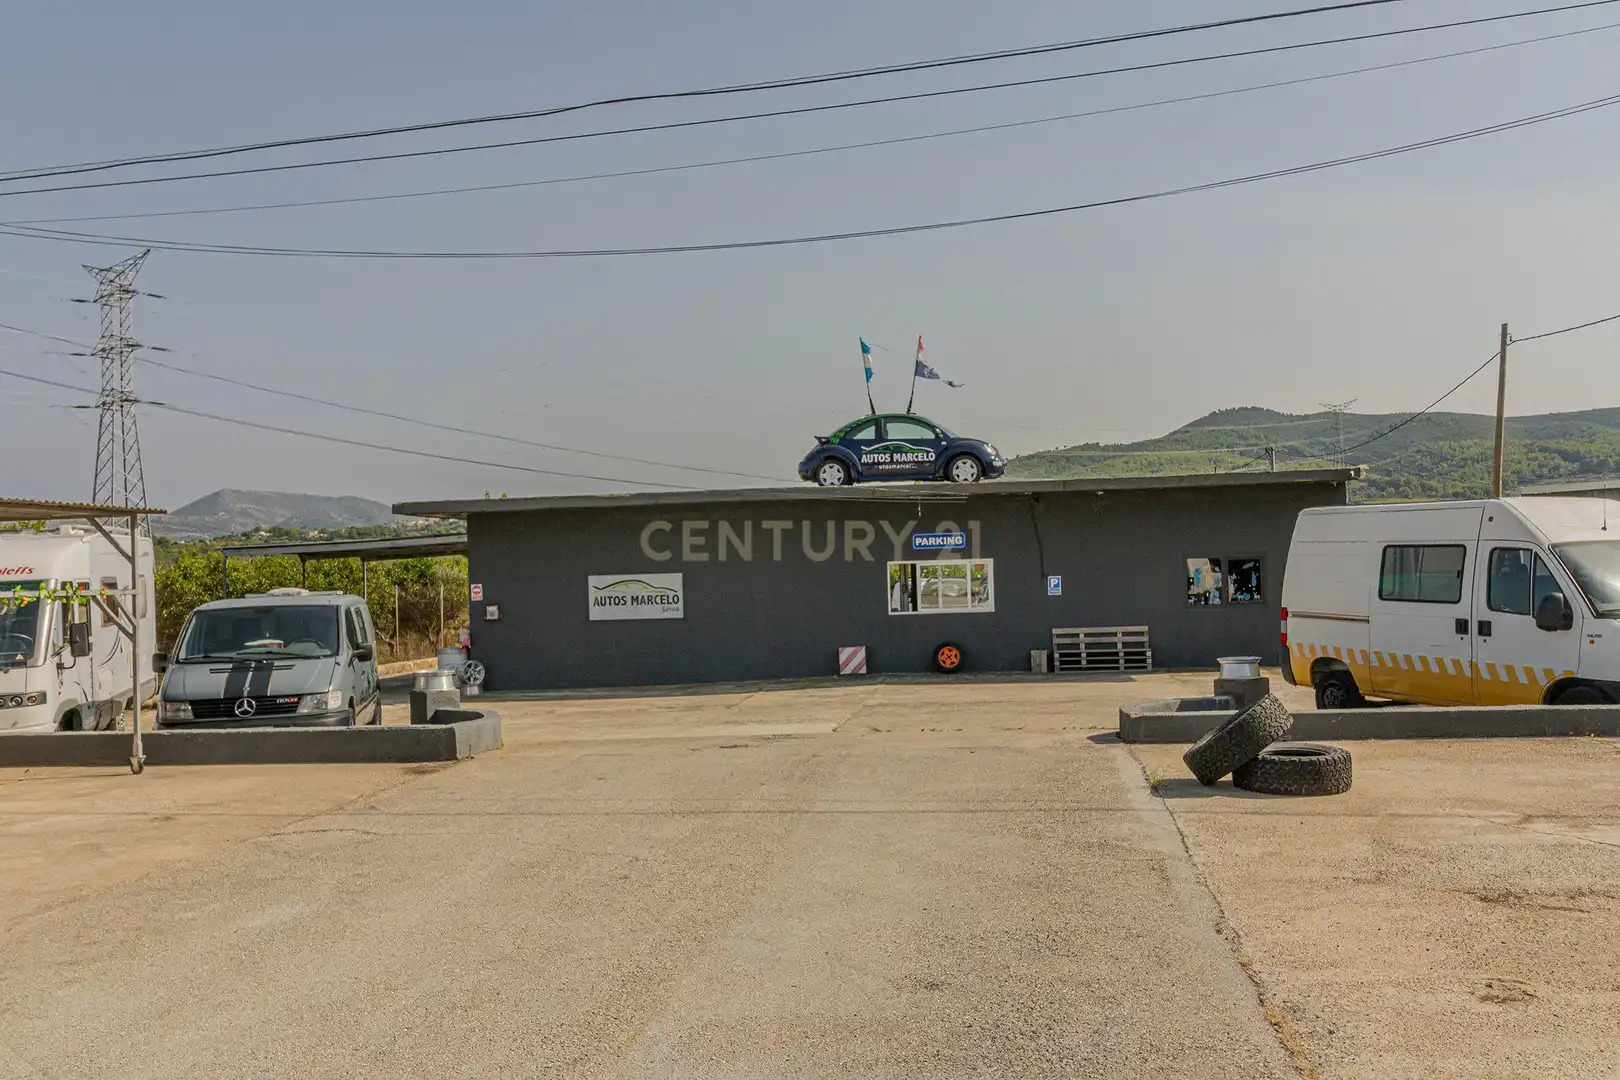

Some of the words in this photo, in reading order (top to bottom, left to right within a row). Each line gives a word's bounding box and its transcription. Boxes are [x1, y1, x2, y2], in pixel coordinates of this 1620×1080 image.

[861, 453, 891, 464] AUTOS
[893, 452, 936, 462] MARCELO
[915, 536, 963, 546] PARKING
[1050, 578, 1059, 588] P
[592, 595, 627, 607] AUTOS
[631, 594, 680, 606] MARCELO
